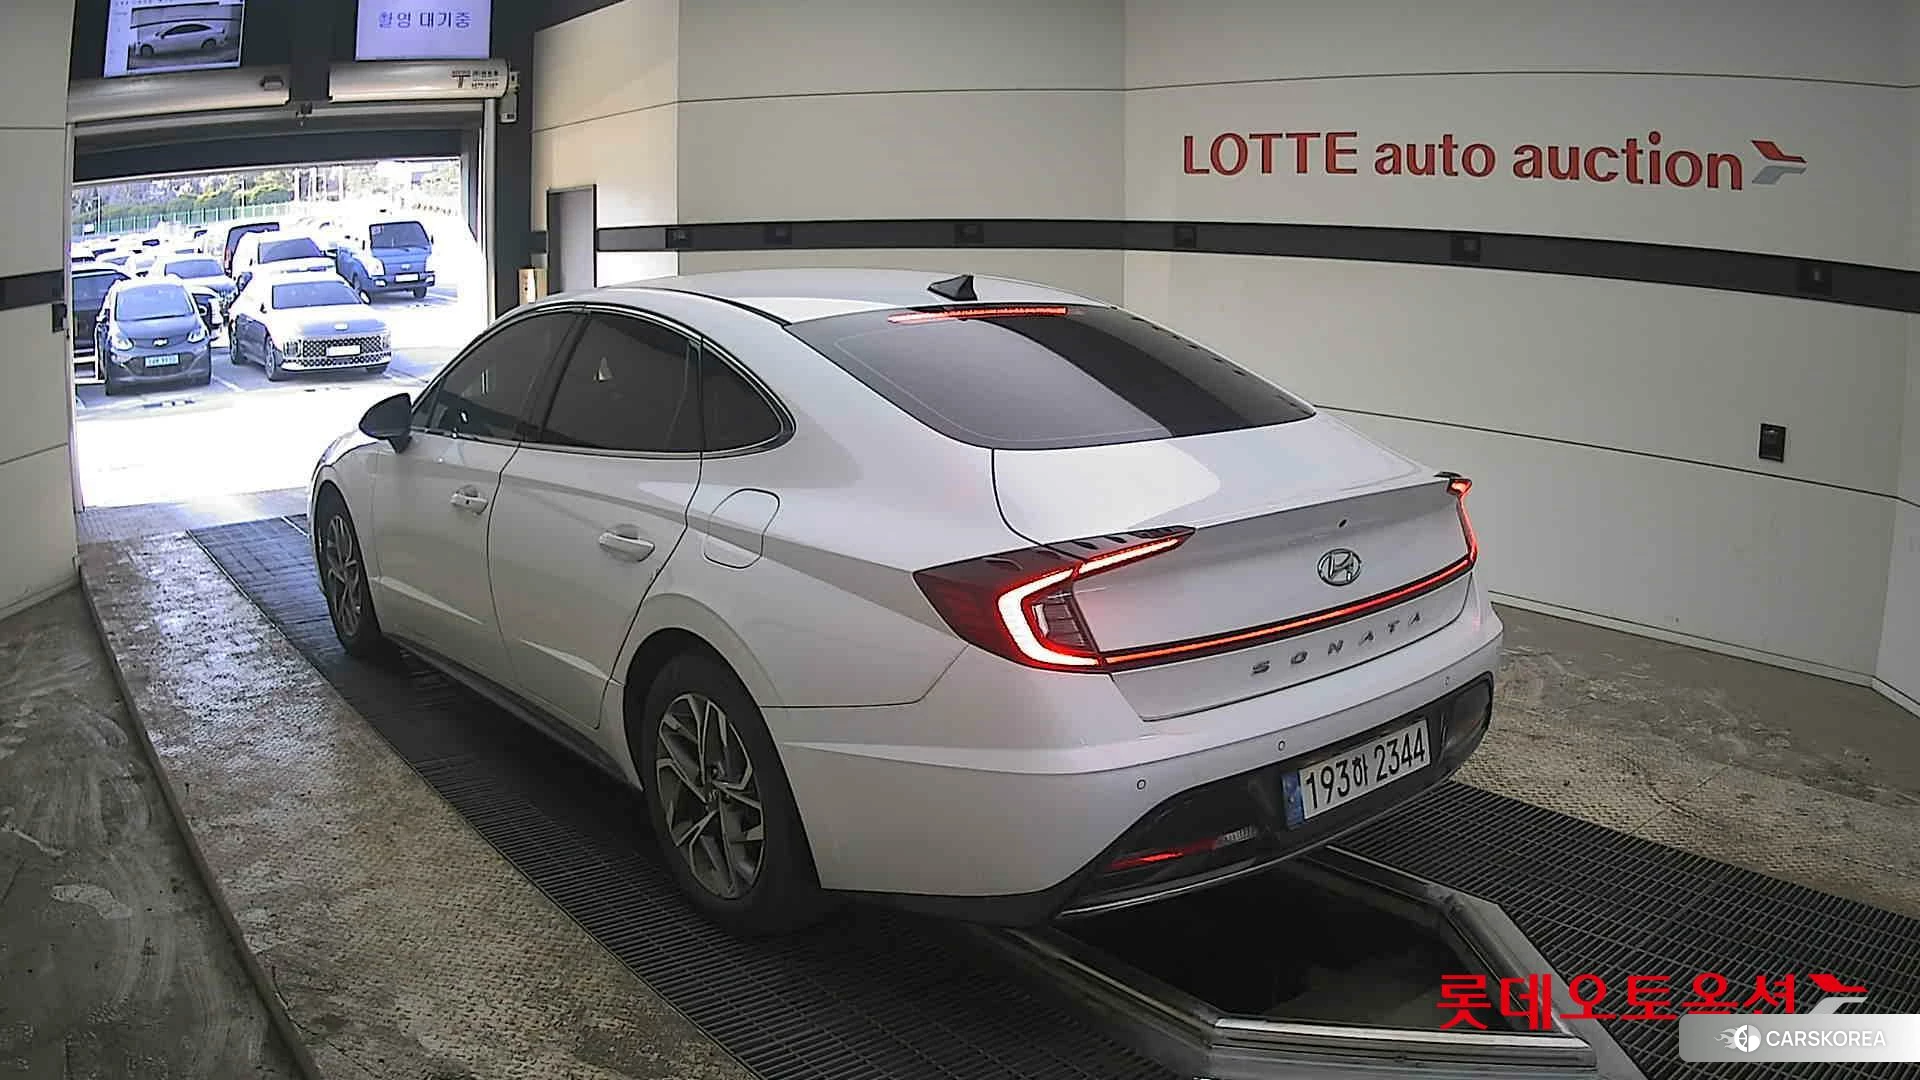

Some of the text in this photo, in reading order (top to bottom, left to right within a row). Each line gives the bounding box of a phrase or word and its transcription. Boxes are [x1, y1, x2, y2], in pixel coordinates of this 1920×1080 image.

[419, 11, 472, 29] 대기중
[1184, 131, 1743, 191] LOTTE auto auction
[1251, 610, 1423, 675] SONATA
[1305, 726, 1427, 810] 193하 2344
